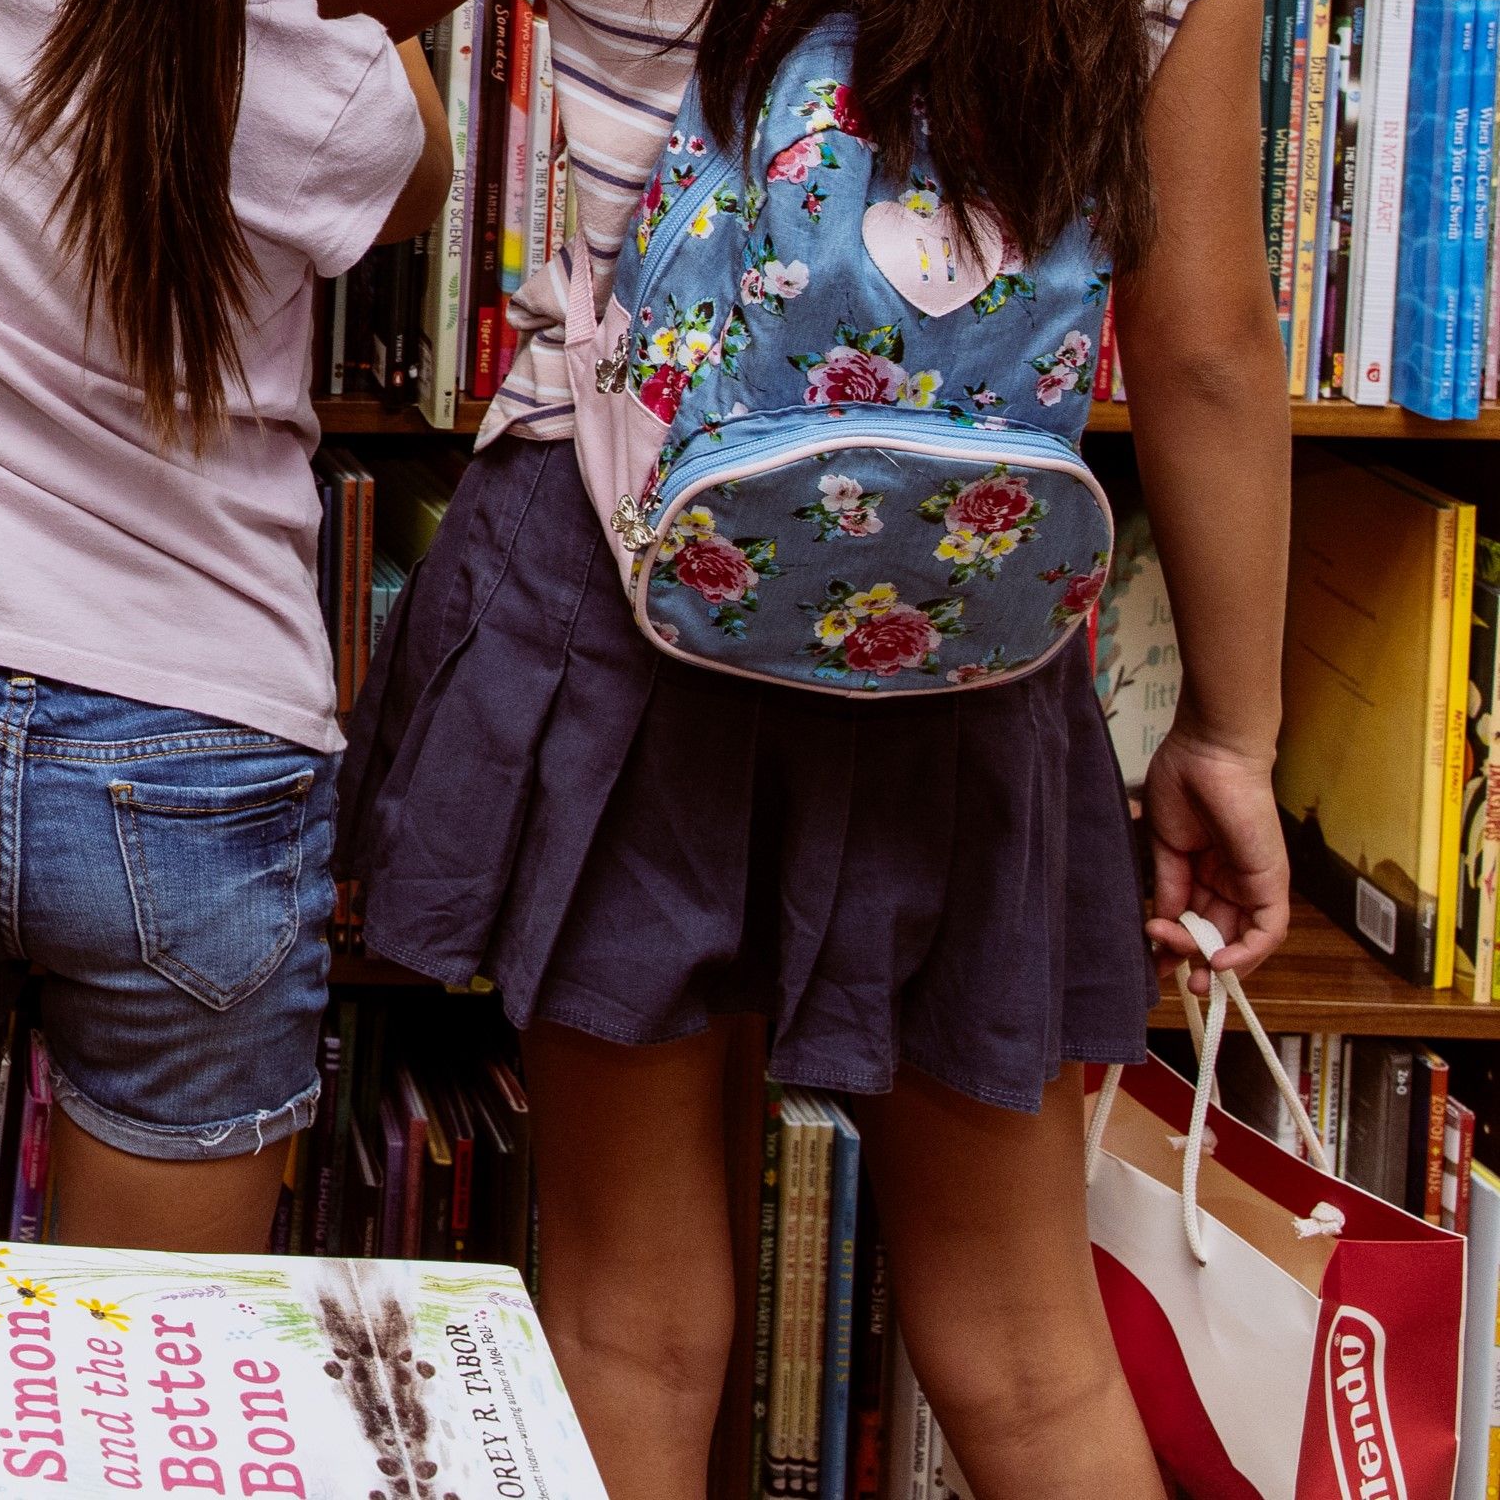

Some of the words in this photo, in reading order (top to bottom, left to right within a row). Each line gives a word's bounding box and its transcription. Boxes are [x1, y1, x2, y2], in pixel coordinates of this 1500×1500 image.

[490, 3, 510, 81] Someday
[1380, 142, 1399, 162] MY
[1383, 121, 1399, 139] IN
[1375, 164, 1398, 235] HEART
[76, 1337, 129, 1397] the
[446, 1324, 492, 1396] TABOR
[148, 1314, 225, 1496] Better
[232, 1358, 307, 1500] Bone
[472, 1403, 501, 1423] R.
[81, 1408, 143, 1490] and
